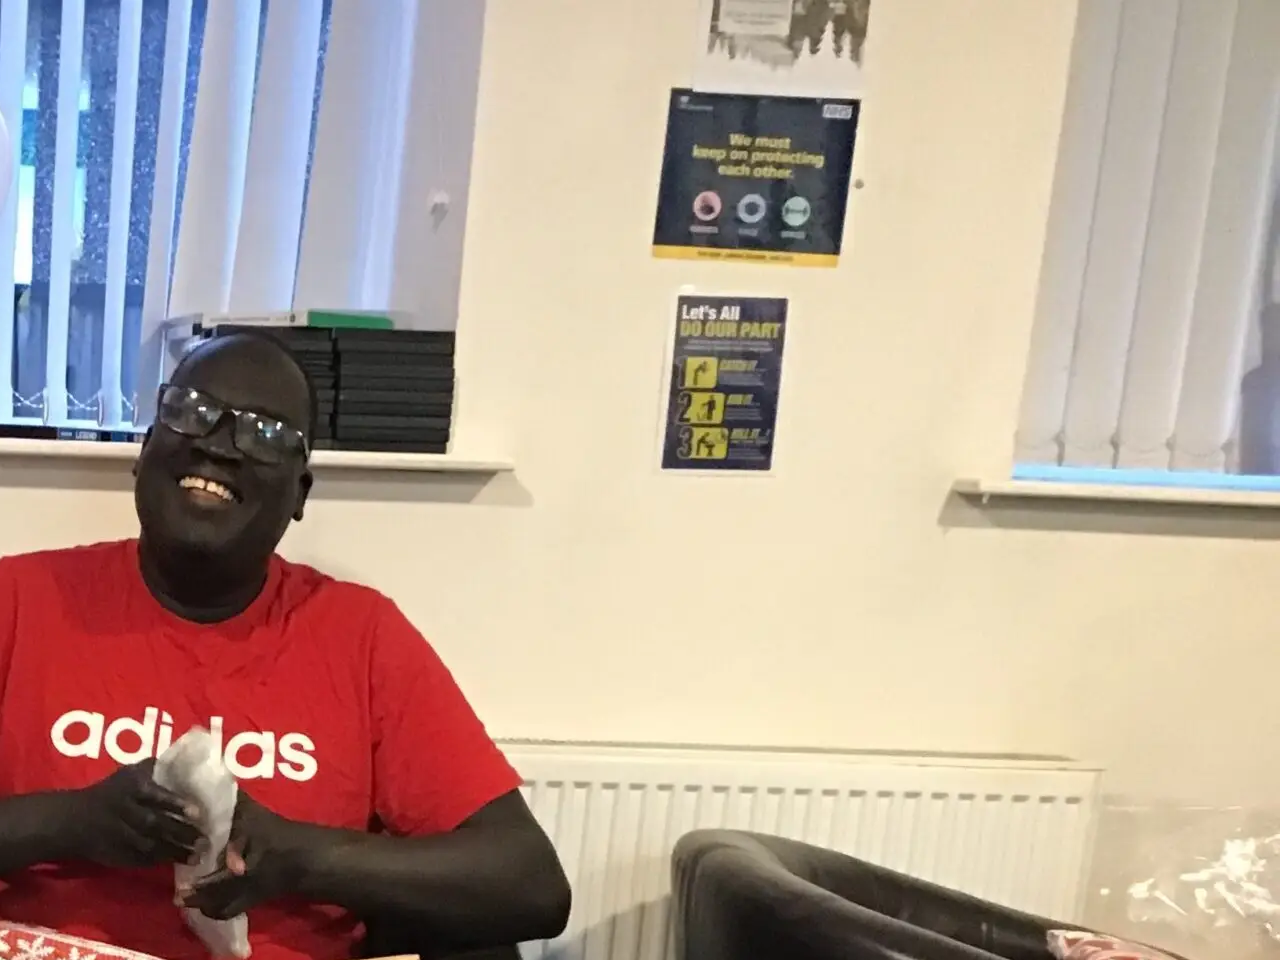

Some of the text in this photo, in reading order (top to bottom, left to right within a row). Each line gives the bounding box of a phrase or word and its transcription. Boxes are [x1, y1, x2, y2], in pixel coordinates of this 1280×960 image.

[730, 133, 791, 149] We must
[692, 144, 824, 168] keep on protecting
[718, 164, 750, 176] each
[682, 304, 740, 320] Let's All
[680, 320, 781, 338] DO OUR PART
[677, 391, 692, 424] 2
[676, 426, 693, 458] 3
[51, 706, 318, 782] adias
